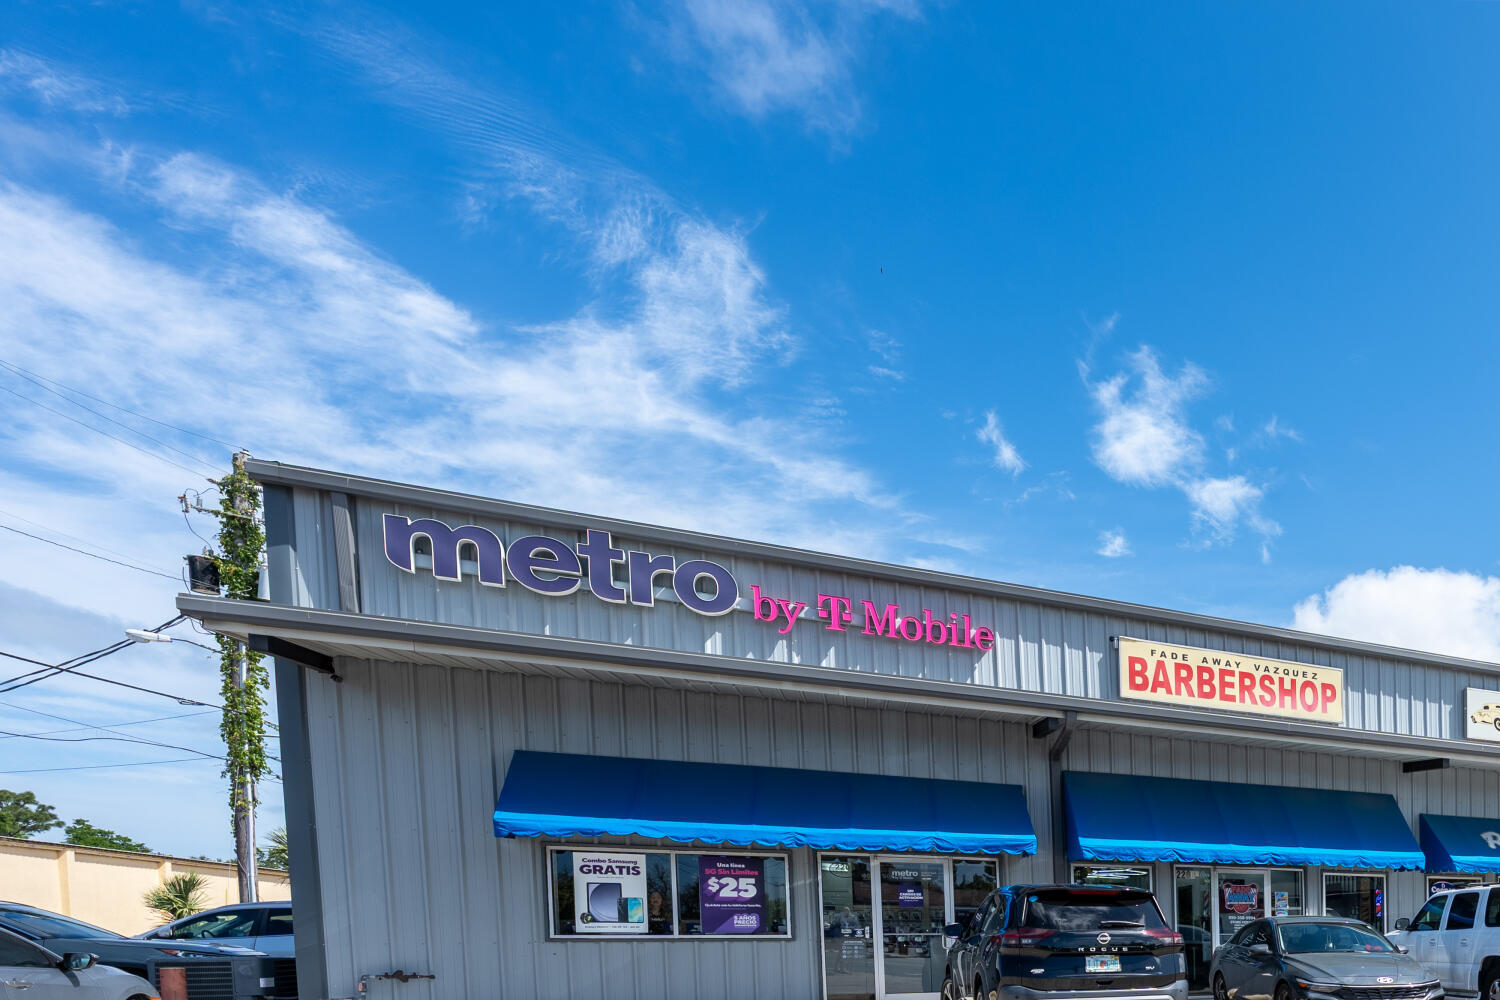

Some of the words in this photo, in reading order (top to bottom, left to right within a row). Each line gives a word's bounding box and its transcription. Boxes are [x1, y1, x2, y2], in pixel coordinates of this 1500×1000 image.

[383, 513, 738, 616] metro
[750, 585, 805, 634] by
[1150, 649, 1189, 662] FADE
[1201, 656, 1241, 669] AWAY
[1253, 664, 1319, 680] VAZQUEZ
[1128, 656, 1337, 714] BARBERSHOP
[579, 864, 641, 876] GRATIS
[707, 876, 757, 898] $25
